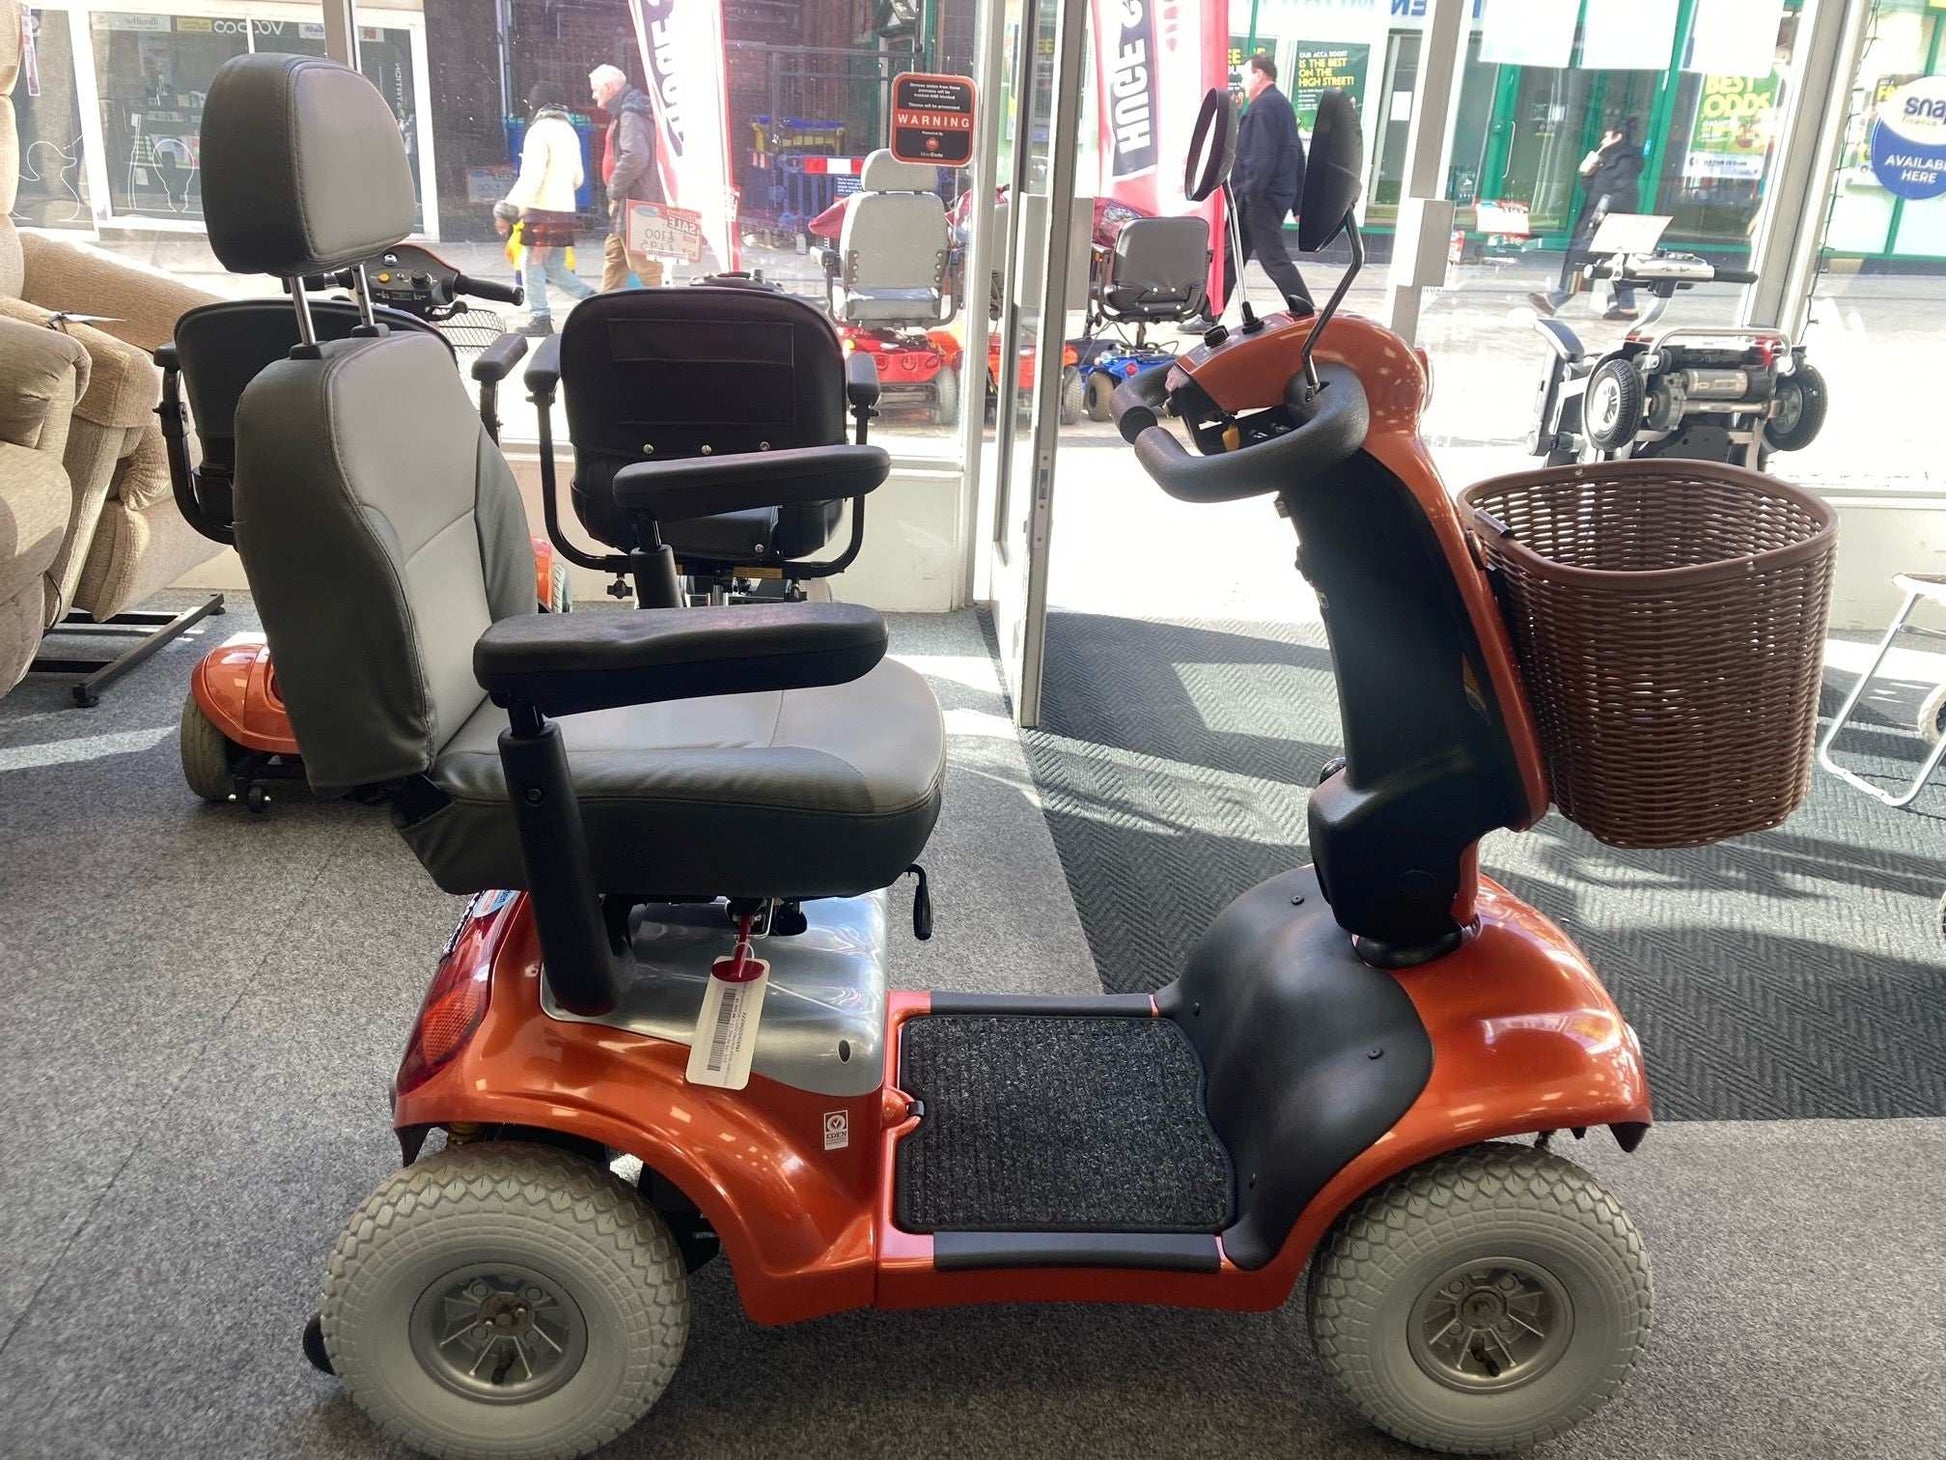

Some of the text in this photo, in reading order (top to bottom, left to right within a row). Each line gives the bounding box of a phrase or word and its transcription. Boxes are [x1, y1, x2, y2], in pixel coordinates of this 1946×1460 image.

[1299, 57, 1348, 68] IS THE BEST
[1299, 67, 1333, 77] ON THE
[1299, 77, 1321, 87] HIGH
[1904, 96, 1946, 125] sna
[898, 113, 969, 128] WARNING
[1901, 170, 1938, 184] HERE
